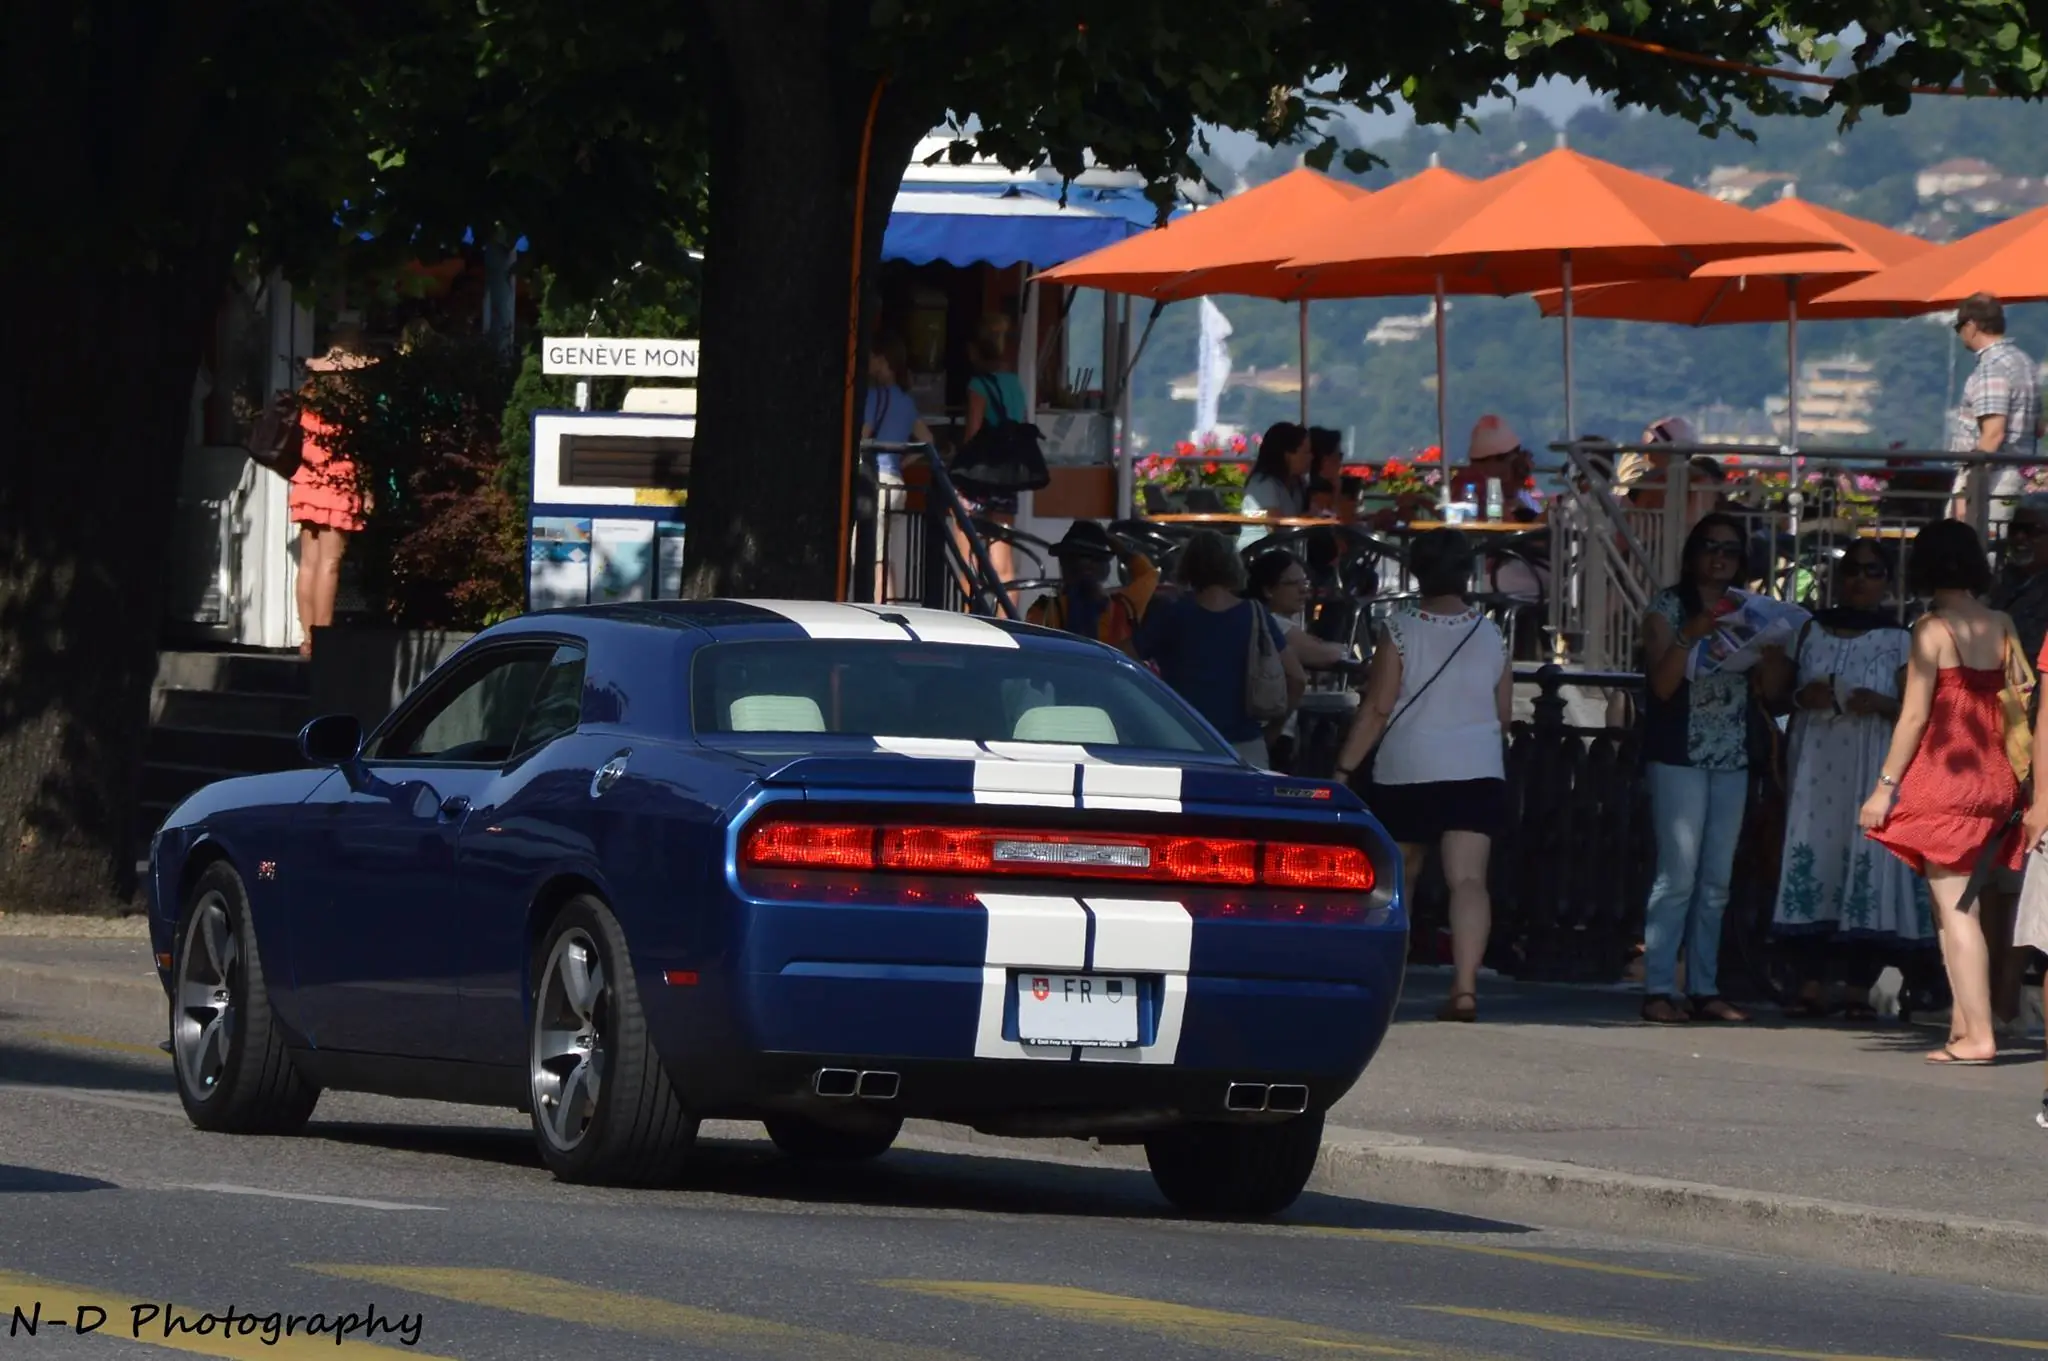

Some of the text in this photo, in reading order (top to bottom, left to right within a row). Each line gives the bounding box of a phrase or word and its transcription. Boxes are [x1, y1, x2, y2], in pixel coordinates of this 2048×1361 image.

[549, 344, 699, 367] GENÈVE MON
[1064, 978, 1092, 1004] FR
